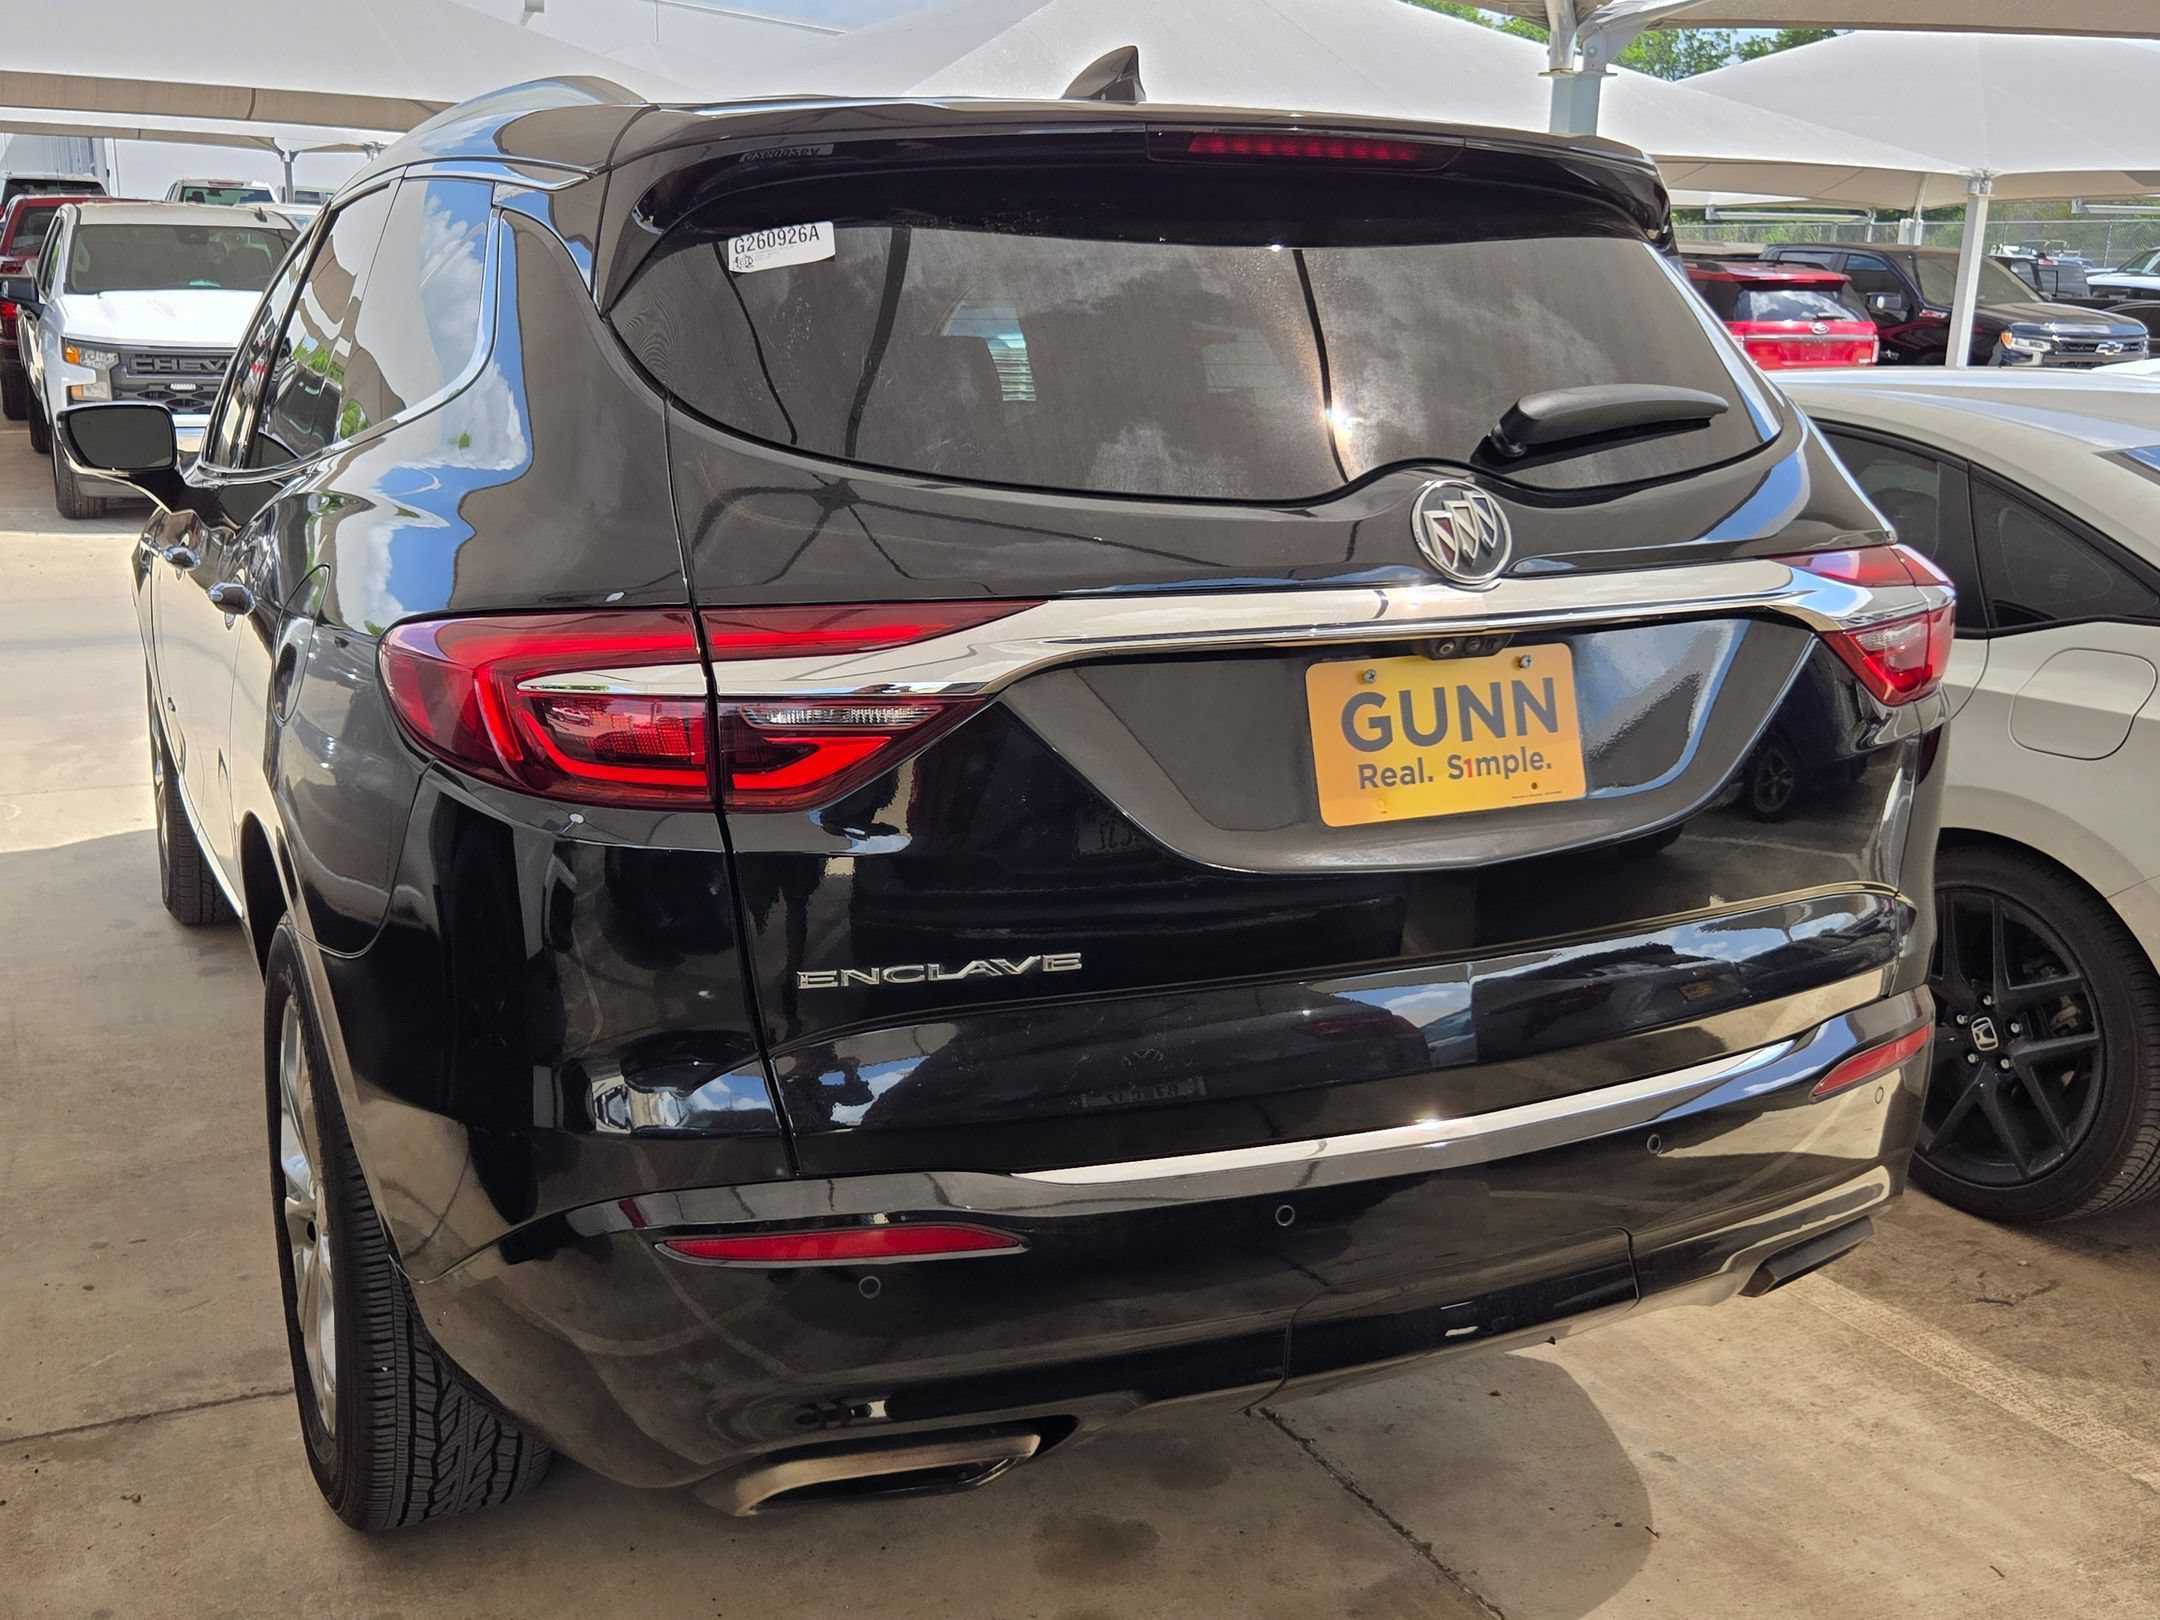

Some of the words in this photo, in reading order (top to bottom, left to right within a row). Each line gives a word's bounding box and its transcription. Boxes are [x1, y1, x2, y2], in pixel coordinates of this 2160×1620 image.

[734, 224, 820, 255] G260926A
[129, 356, 229, 374] CHEV
[1341, 677, 1559, 753] GUNN
[1358, 757, 1434, 790] Real.
[796, 952, 1082, 989] ENCLAVE
